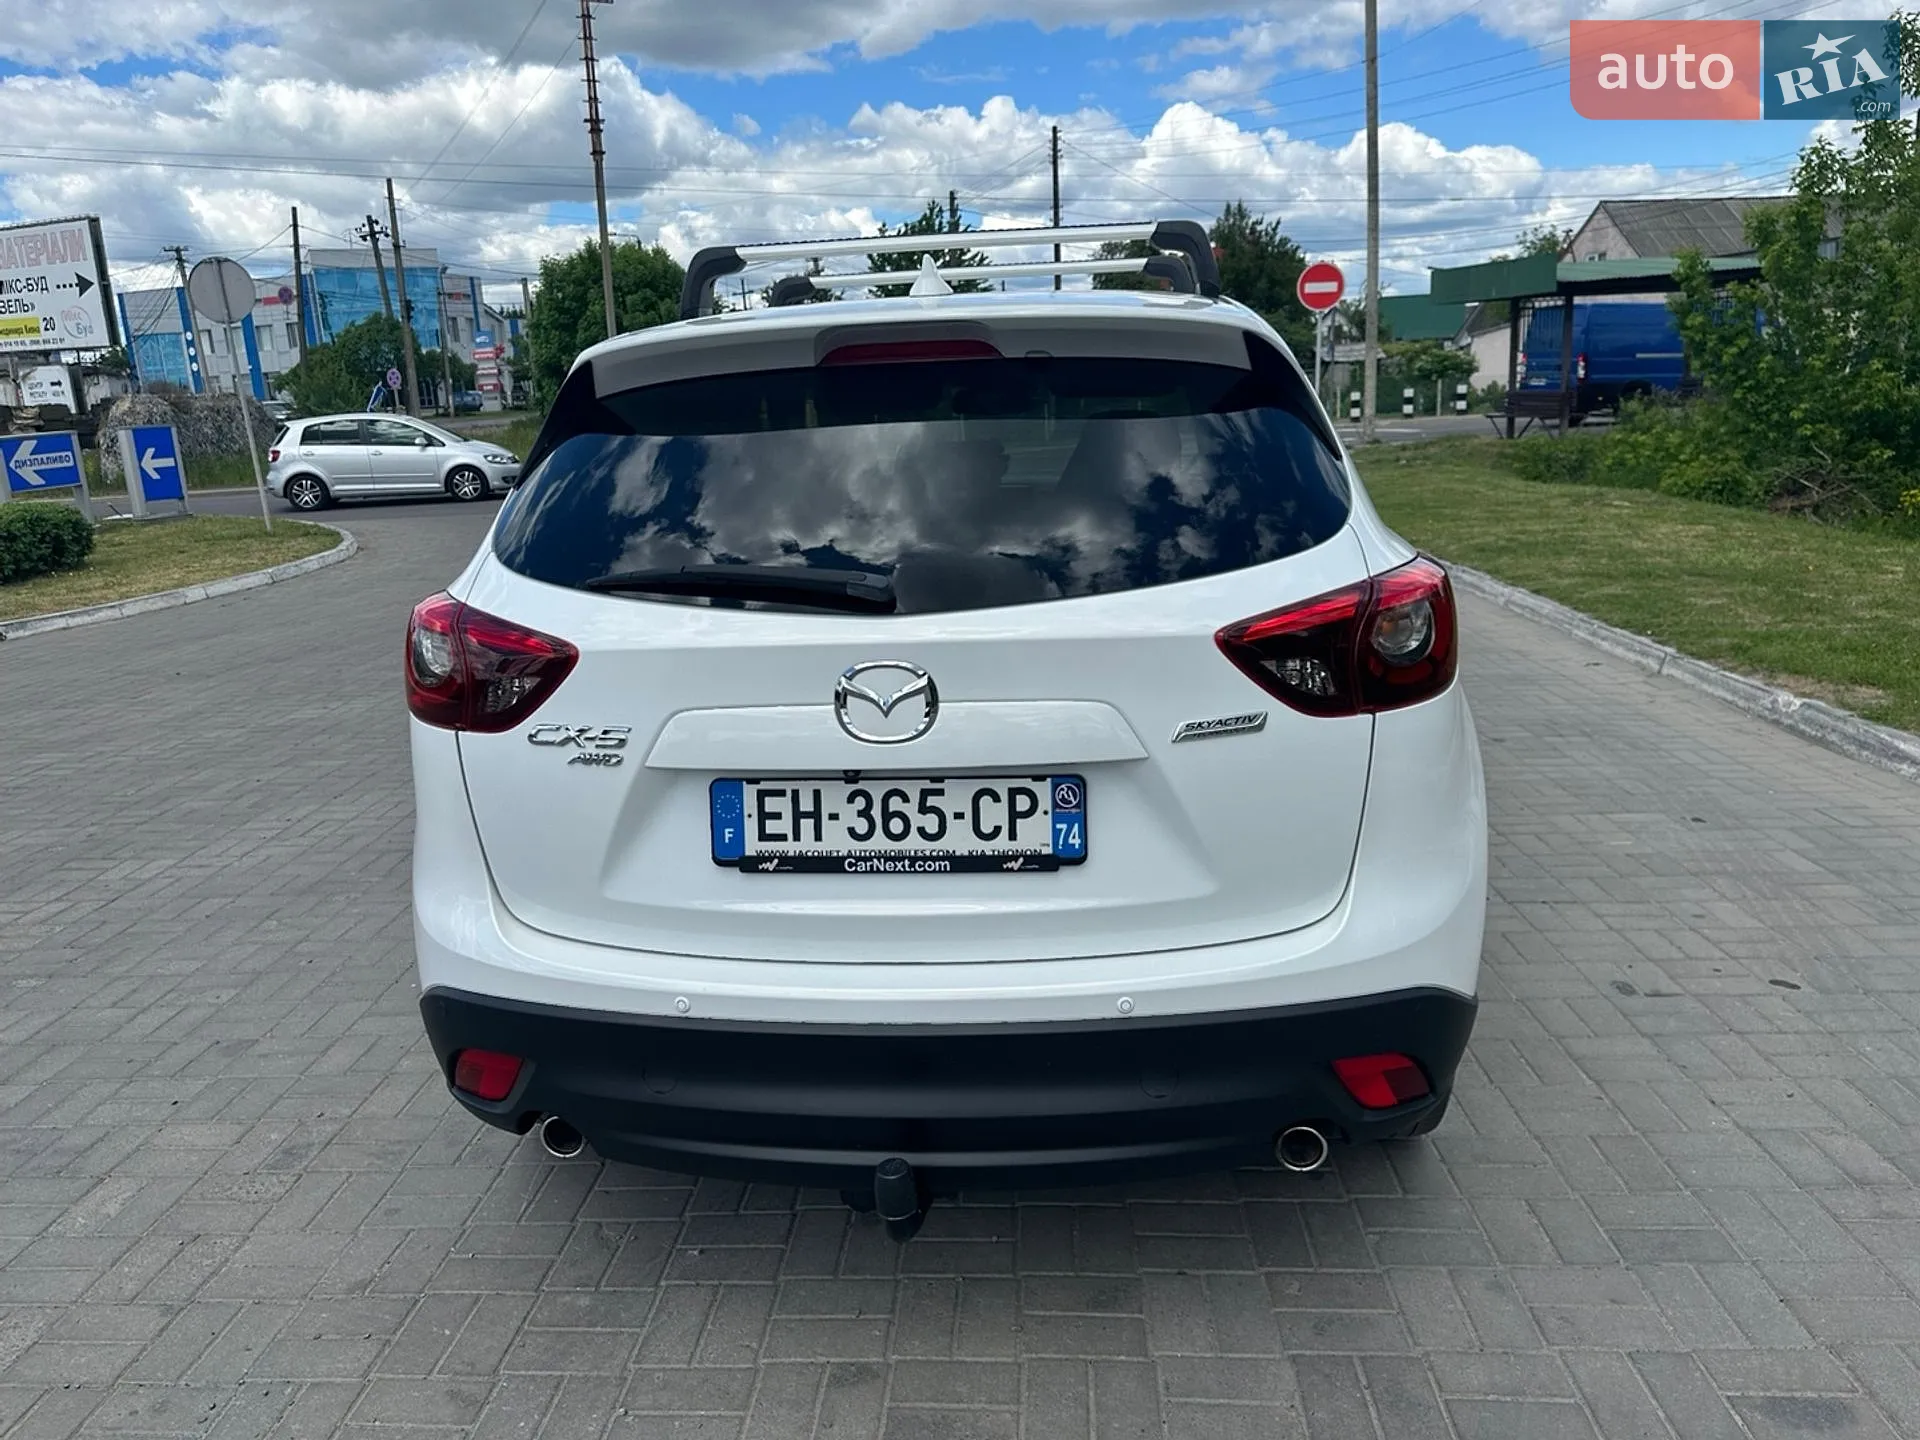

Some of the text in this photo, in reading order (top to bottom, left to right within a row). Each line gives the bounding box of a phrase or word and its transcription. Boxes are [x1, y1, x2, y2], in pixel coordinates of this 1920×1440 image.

[0, 228, 88, 270] АТЕРІАЛИ
[42, 316, 56, 332] 20
[14, 454, 71, 470] ДИЗПАЛИВО
[1185, 713, 1258, 731] SKYACTIV
[527, 724, 632, 748] CX-5
[567, 752, 624, 766] AWD
[756, 787, 1039, 842] EH-365-CP
[724, 829, 733, 843] F
[1055, 822, 1081, 849] 74
[844, 858, 950, 872] CarNext.com
